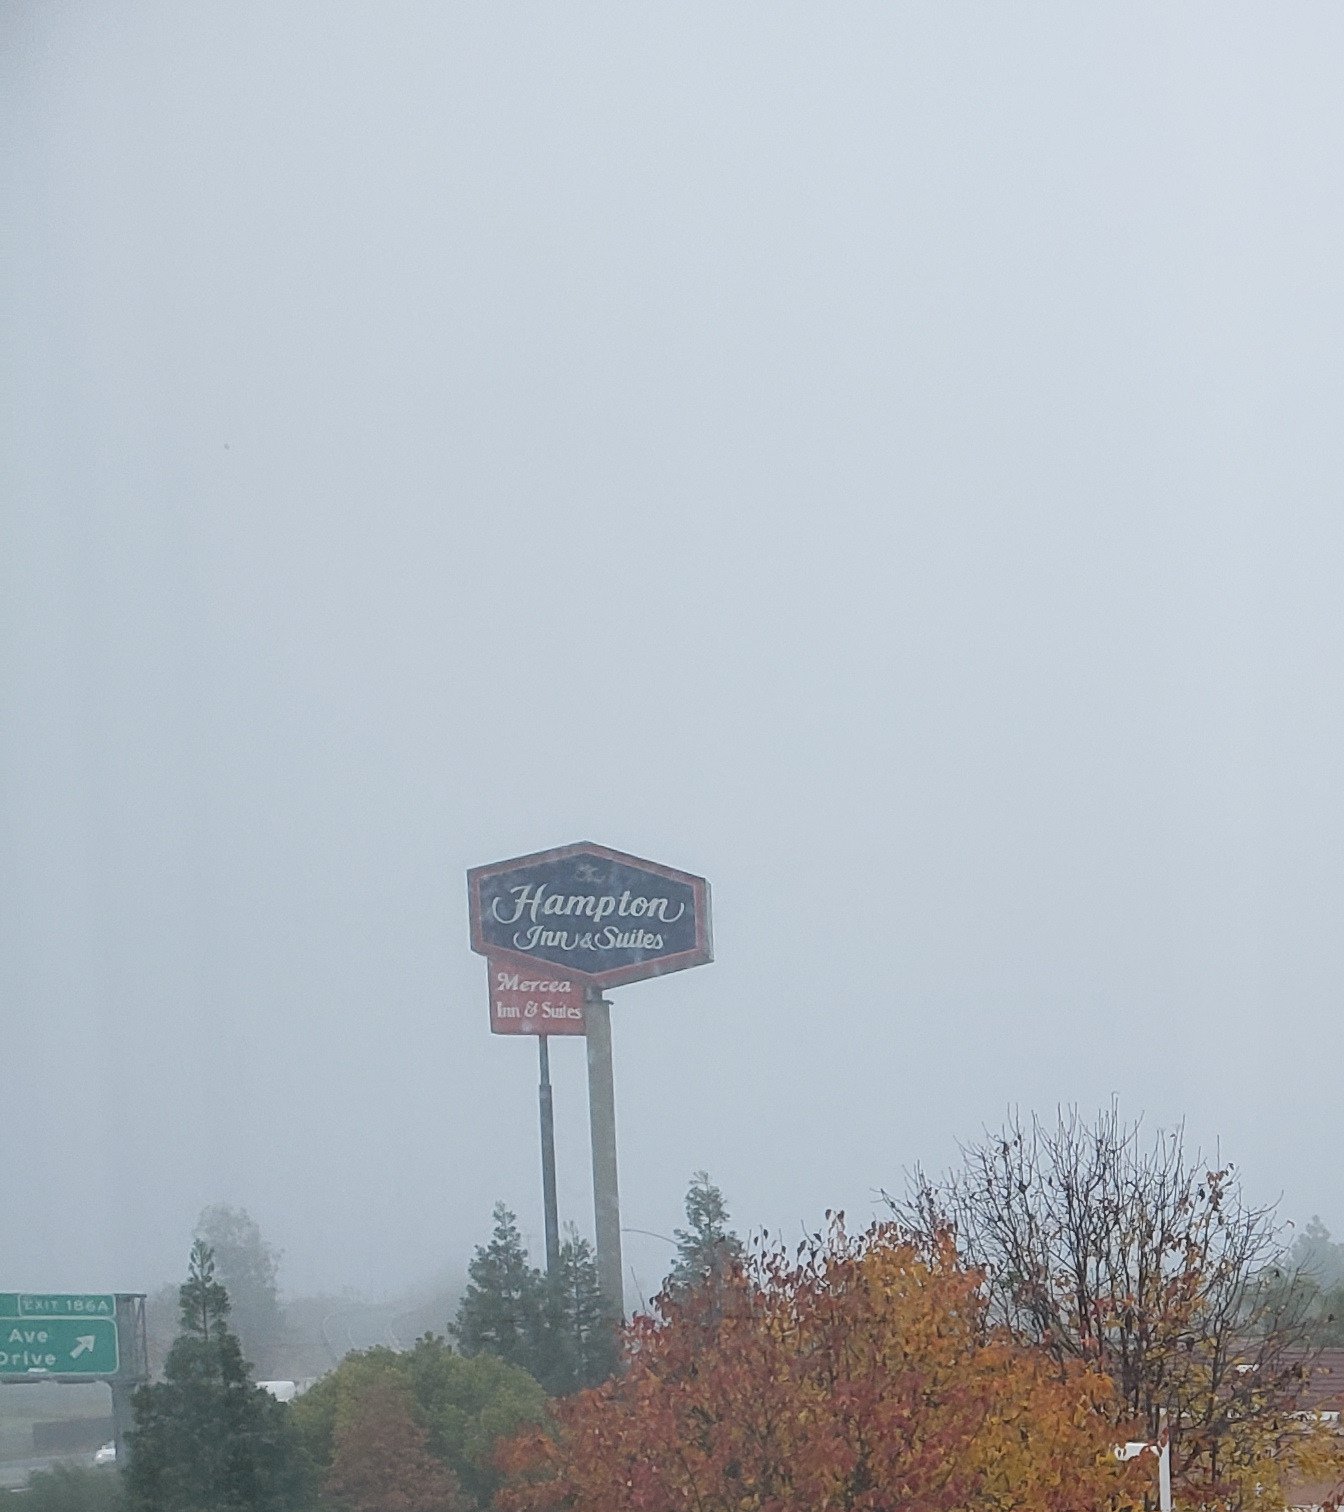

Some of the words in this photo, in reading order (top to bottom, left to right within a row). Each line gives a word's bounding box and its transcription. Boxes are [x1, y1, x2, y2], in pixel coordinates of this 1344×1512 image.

[491, 883, 685, 925] Hampton
[513, 925, 579, 950] Inn
[579, 932, 598, 950] &
[594, 926, 664, 950] Suites
[496, 1001, 521, 1018] Inn
[524, 1001, 538, 1018] &
[541, 1001, 583, 1019] Suites
[24, 1299, 58, 1311] EXIT
[66, 1300, 110, 1313] 186A
[9, 1328, 49, 1343] Ave
